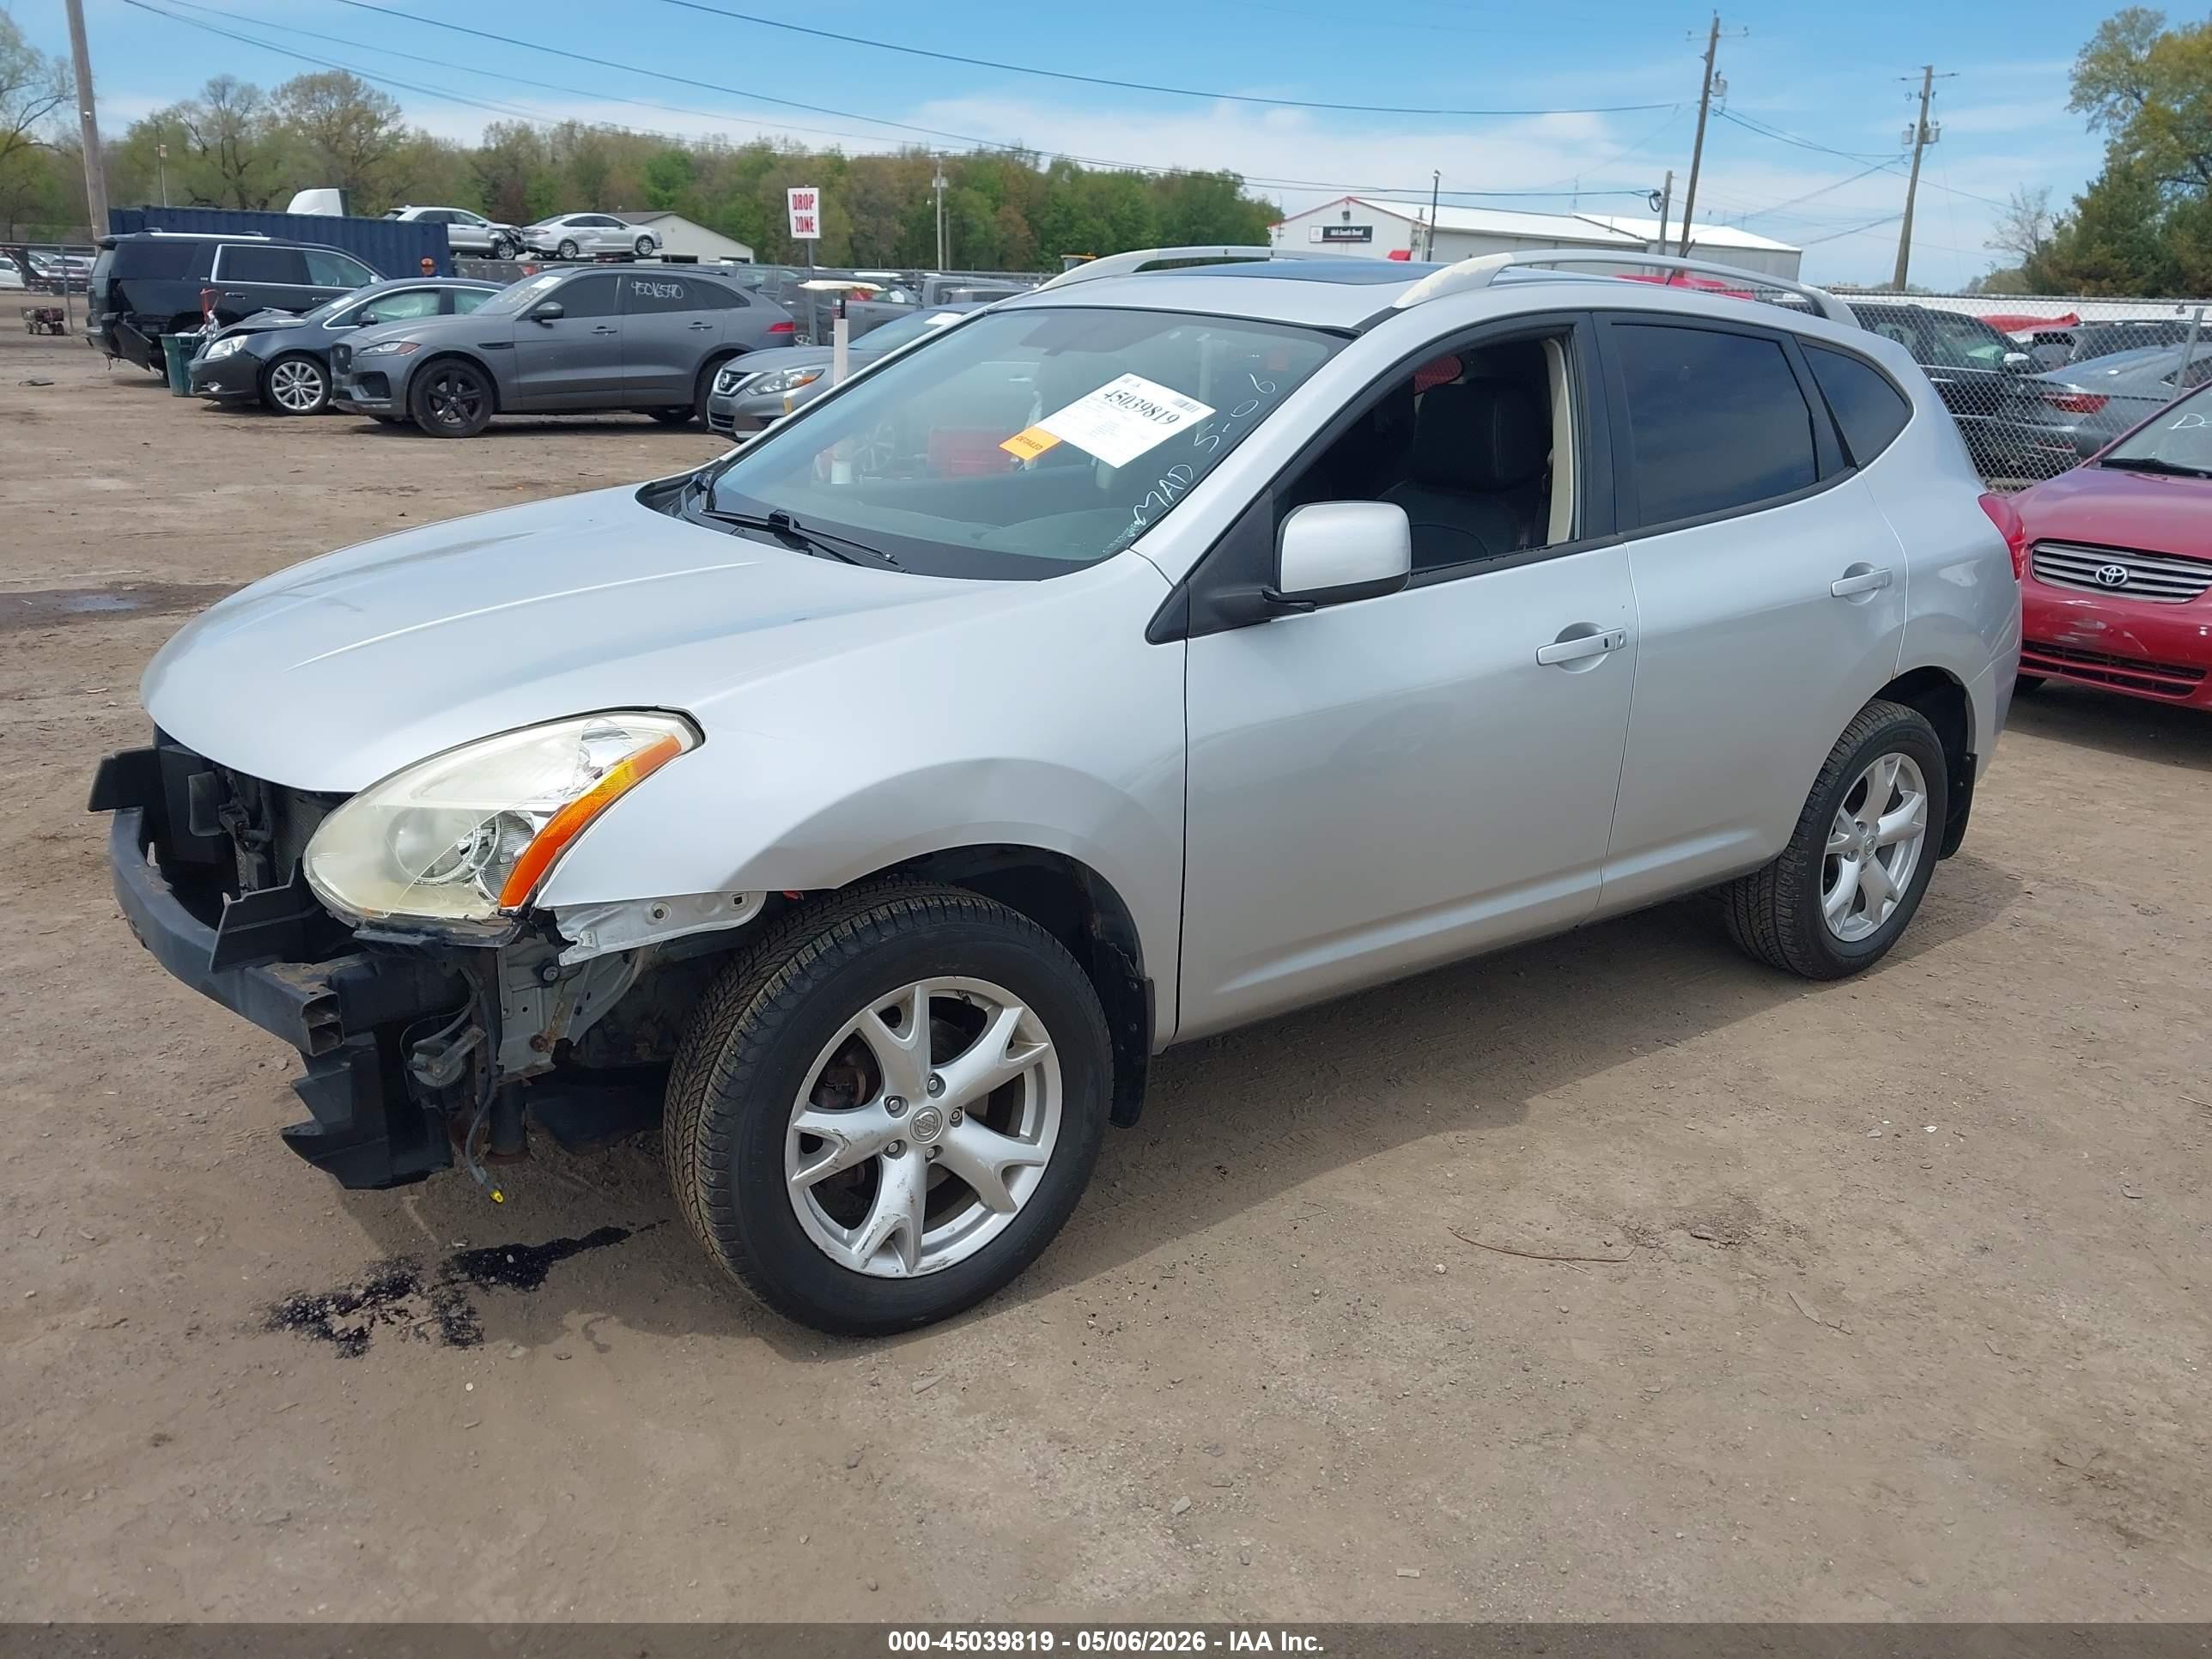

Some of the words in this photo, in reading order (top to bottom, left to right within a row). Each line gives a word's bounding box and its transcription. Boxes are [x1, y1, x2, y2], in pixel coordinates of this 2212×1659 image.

[793, 193, 814, 210] DROP
[794, 216, 814, 233] ZONE
[1103, 389, 1181, 425] 45039819
[1015, 435, 1044, 451] DETAILED
[1133, 464, 1194, 526] MAD
